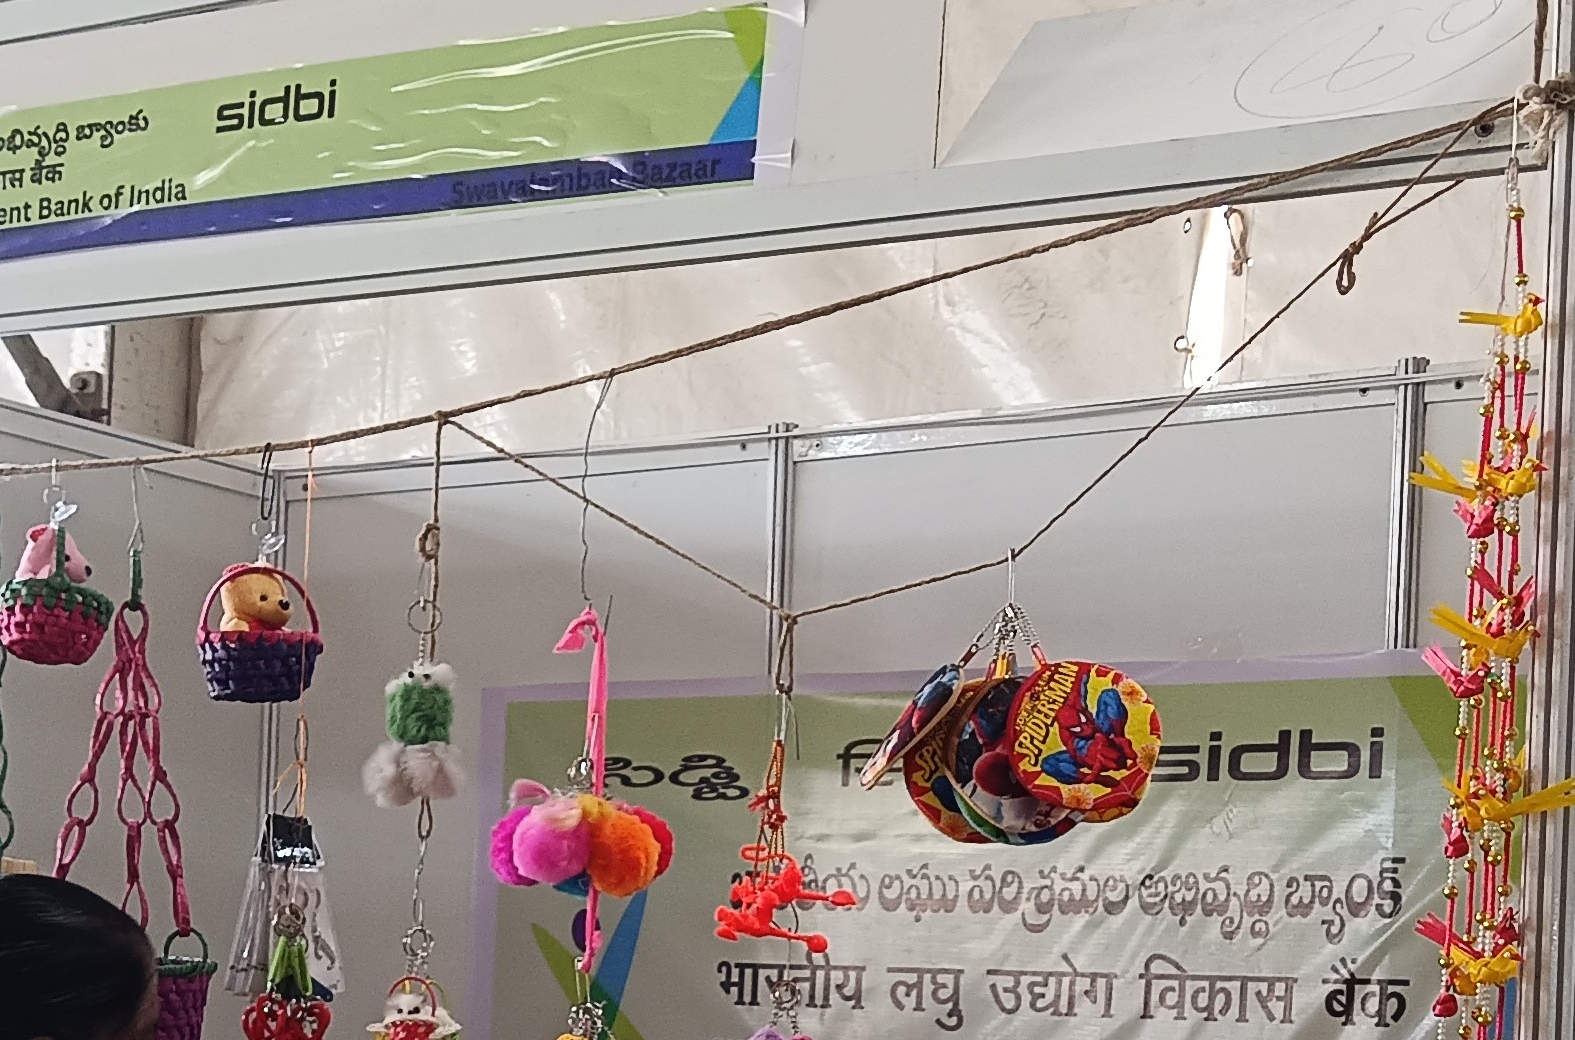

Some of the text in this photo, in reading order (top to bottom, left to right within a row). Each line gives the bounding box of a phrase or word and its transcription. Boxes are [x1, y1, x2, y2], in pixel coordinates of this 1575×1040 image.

[76, 109, 150, 148] బ్యాంకు
[215, 79, 338, 134] sidbi
[630, 157, 723, 186] Bazaar
[38, 191, 94, 220] Bank
[100, 185, 125, 211] of
[129, 178, 188, 208] India
[1149, 727, 1385, 783] sidbi
[886, 967, 965, 1031] लघु
[986, 952, 1118, 1019] उद्योग
[1139, 953, 1298, 1024] विकास
[1321, 956, 1410, 1027] बैंक
